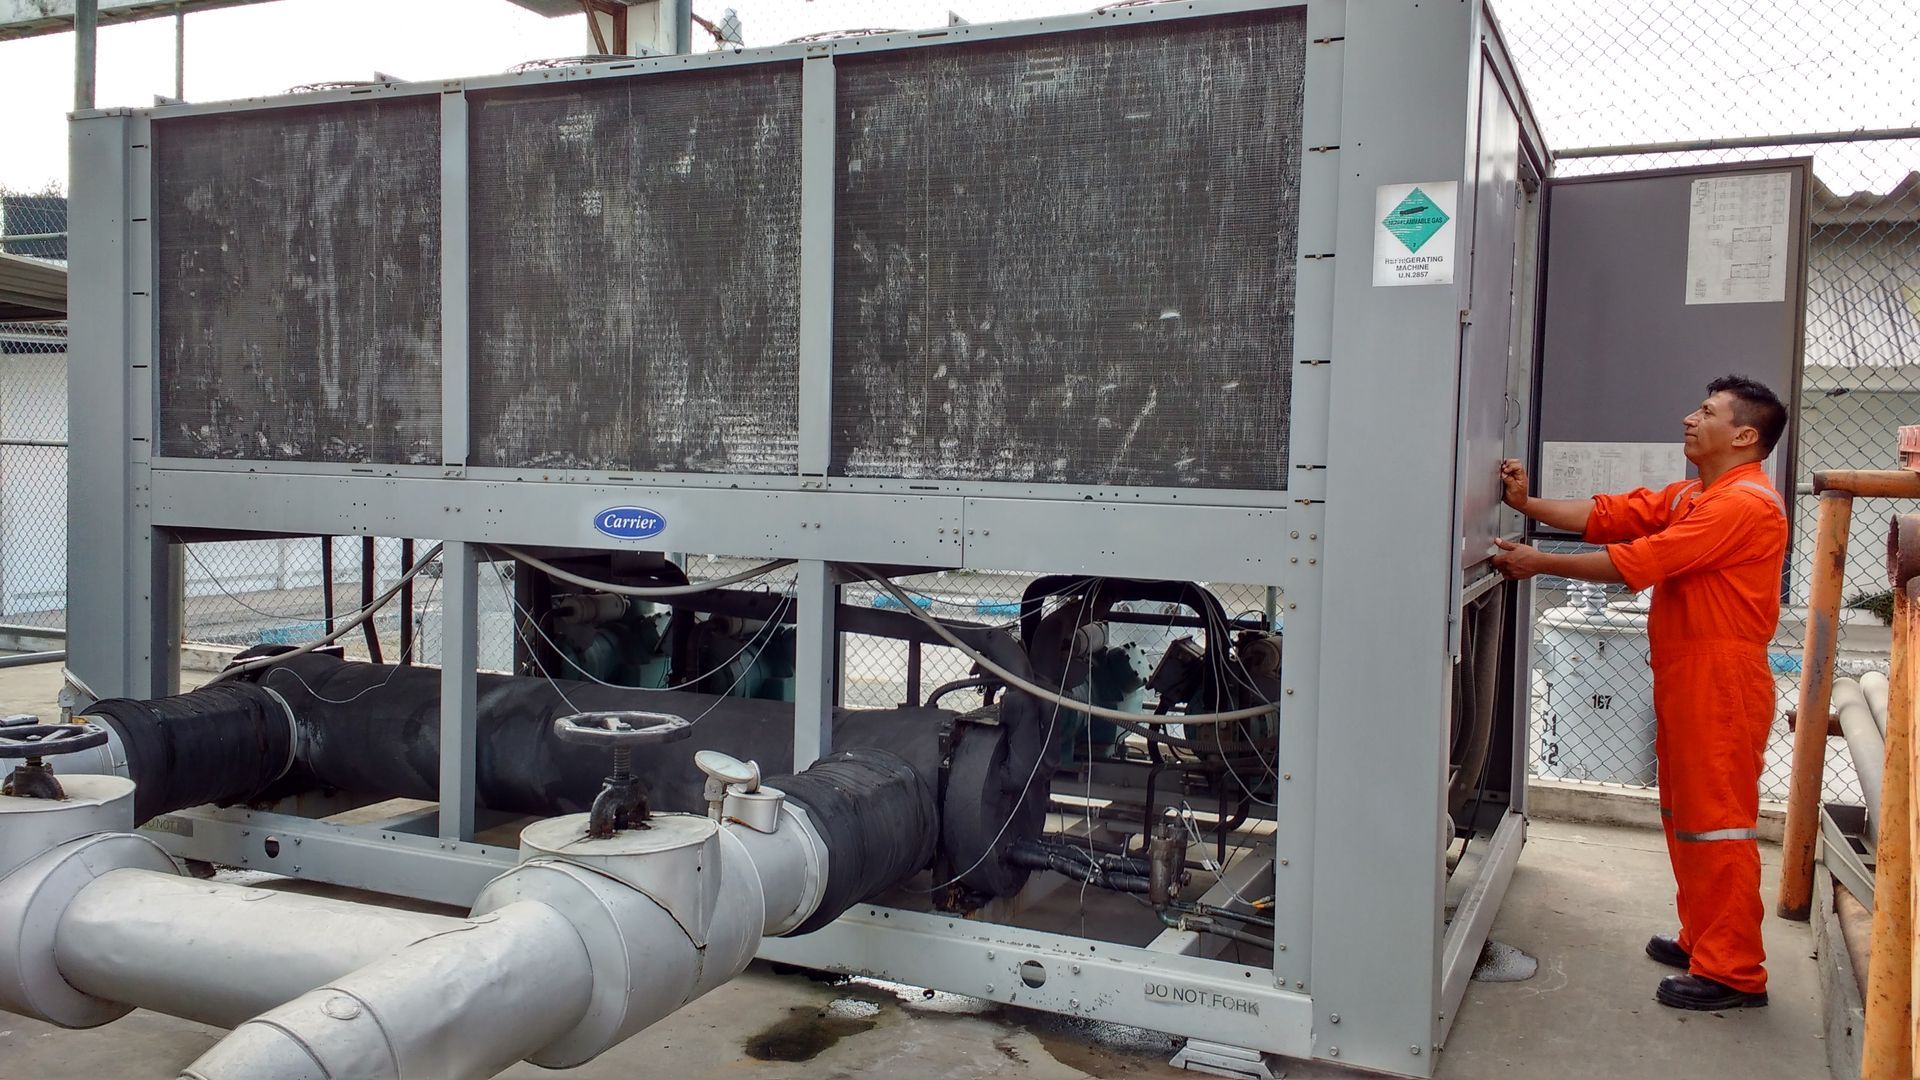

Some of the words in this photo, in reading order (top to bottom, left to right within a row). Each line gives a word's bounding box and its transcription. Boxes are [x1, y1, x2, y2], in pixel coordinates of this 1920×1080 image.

[1398, 271, 1429, 279] U.N.2857
[604, 513, 656, 529] Carrier
[1591, 694, 1612, 710] 167
[156, 819, 176, 830] NOT
[1144, 982, 1168, 998] DO
[1173, 987, 1207, 1005] NOT
[1212, 993, 1260, 1017] FORK
